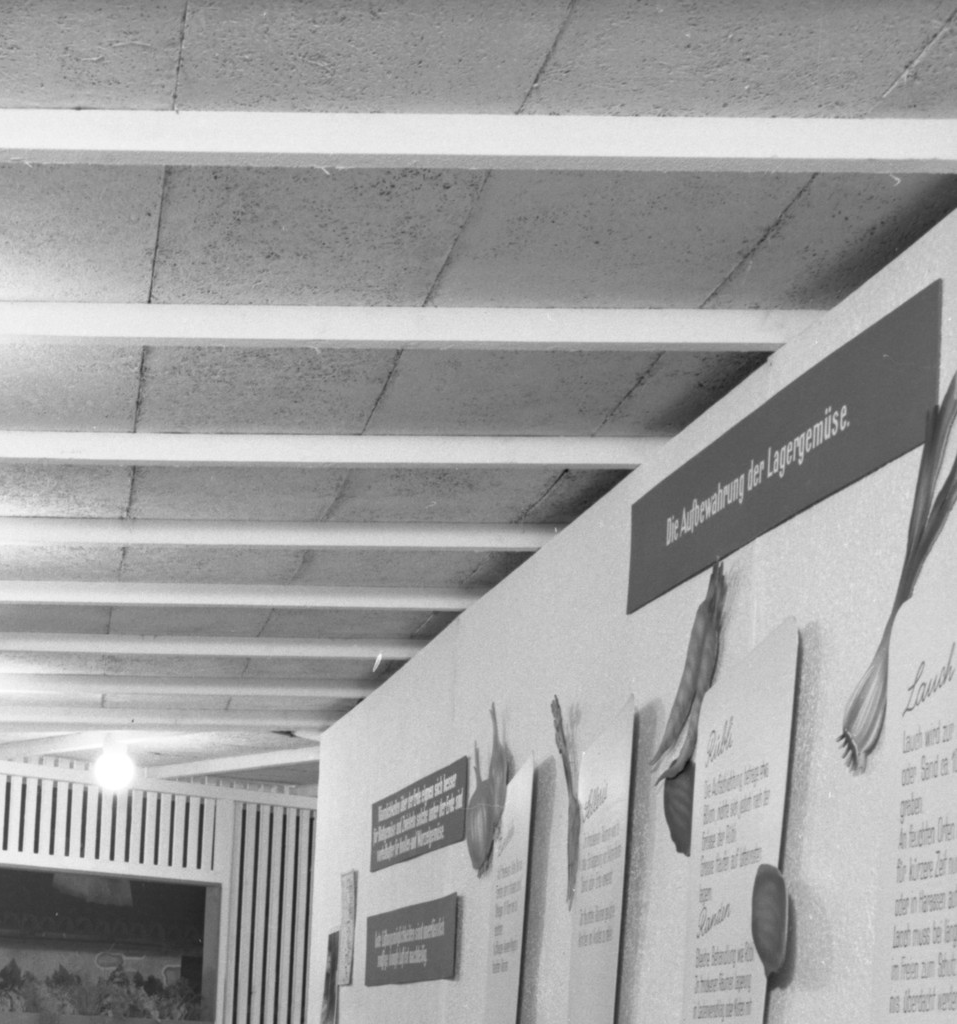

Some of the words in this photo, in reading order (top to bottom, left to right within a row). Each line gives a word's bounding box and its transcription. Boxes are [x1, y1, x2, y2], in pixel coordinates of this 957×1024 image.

[665, 514, 680, 547] Die
[680, 474, 746, 535] Aufbewahrung
[747, 458, 766, 492] der
[766, 404, 851, 479] Lagergemüse.
[902, 642, 956, 718] Lauch
[902, 727, 923, 754] Lauch
[925, 720, 941, 748] wird
[901, 763, 917, 787] oder
[921, 754, 939, 782] Sand
[908, 821, 936, 849] feuchten
[937, 816, 956, 844] Orten
[896, 857, 907, 883] für
[894, 892, 910, 917] oder
[912, 926, 931, 948] muss
